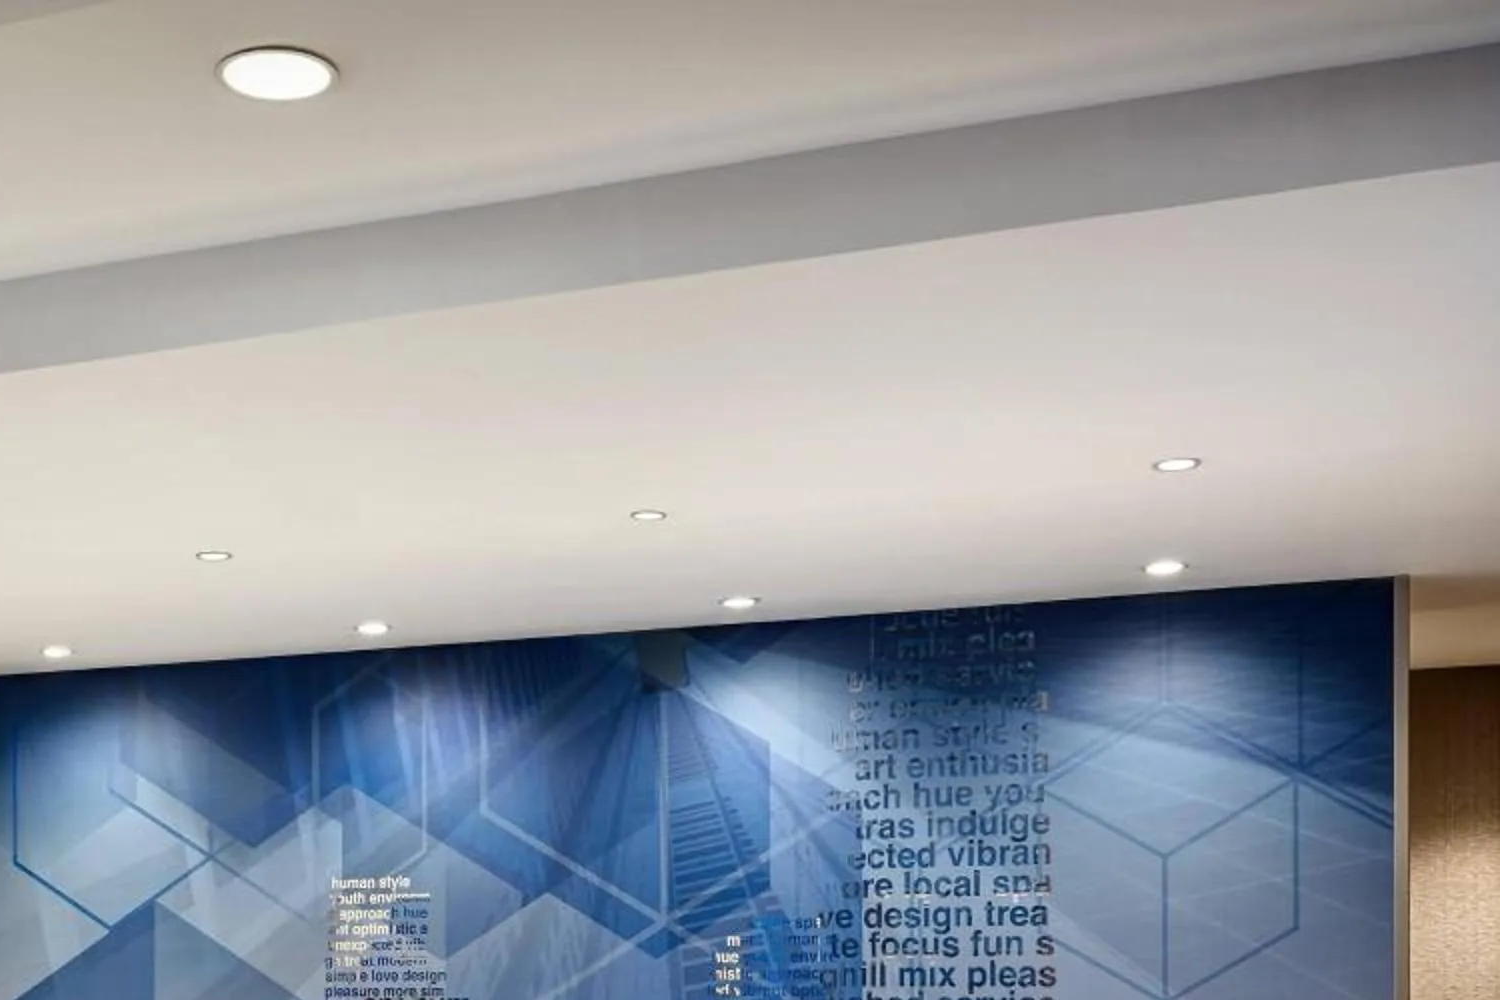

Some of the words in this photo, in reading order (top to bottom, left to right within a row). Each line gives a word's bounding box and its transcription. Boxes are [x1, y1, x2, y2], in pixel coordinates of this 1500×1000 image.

[855, 754, 897, 781] art
[905, 751, 1049, 778] enthusia
[913, 782, 974, 809] hue
[985, 783, 1046, 813] you
[927, 809, 1051, 843] indulge
[850, 842, 936, 870] ected
[948, 839, 1051, 867] vibran
[331, 875, 376, 889] human
[904, 870, 981, 897] local
[331, 893, 367, 906] outh
[864, 902, 973, 935] design
[986, 901, 1048, 927] trea
[869, 931, 961, 958] focus
[971, 930, 1023, 957] fun
[1036, 934, 1056, 957] s
[325, 970, 368, 985] simpe
[371, 970, 400, 983] love
[402, 970, 447, 985] design
[899, 964, 957, 988] mix
[967, 959, 1058, 994] pleas
[324, 985, 380, 1000] pleasure
